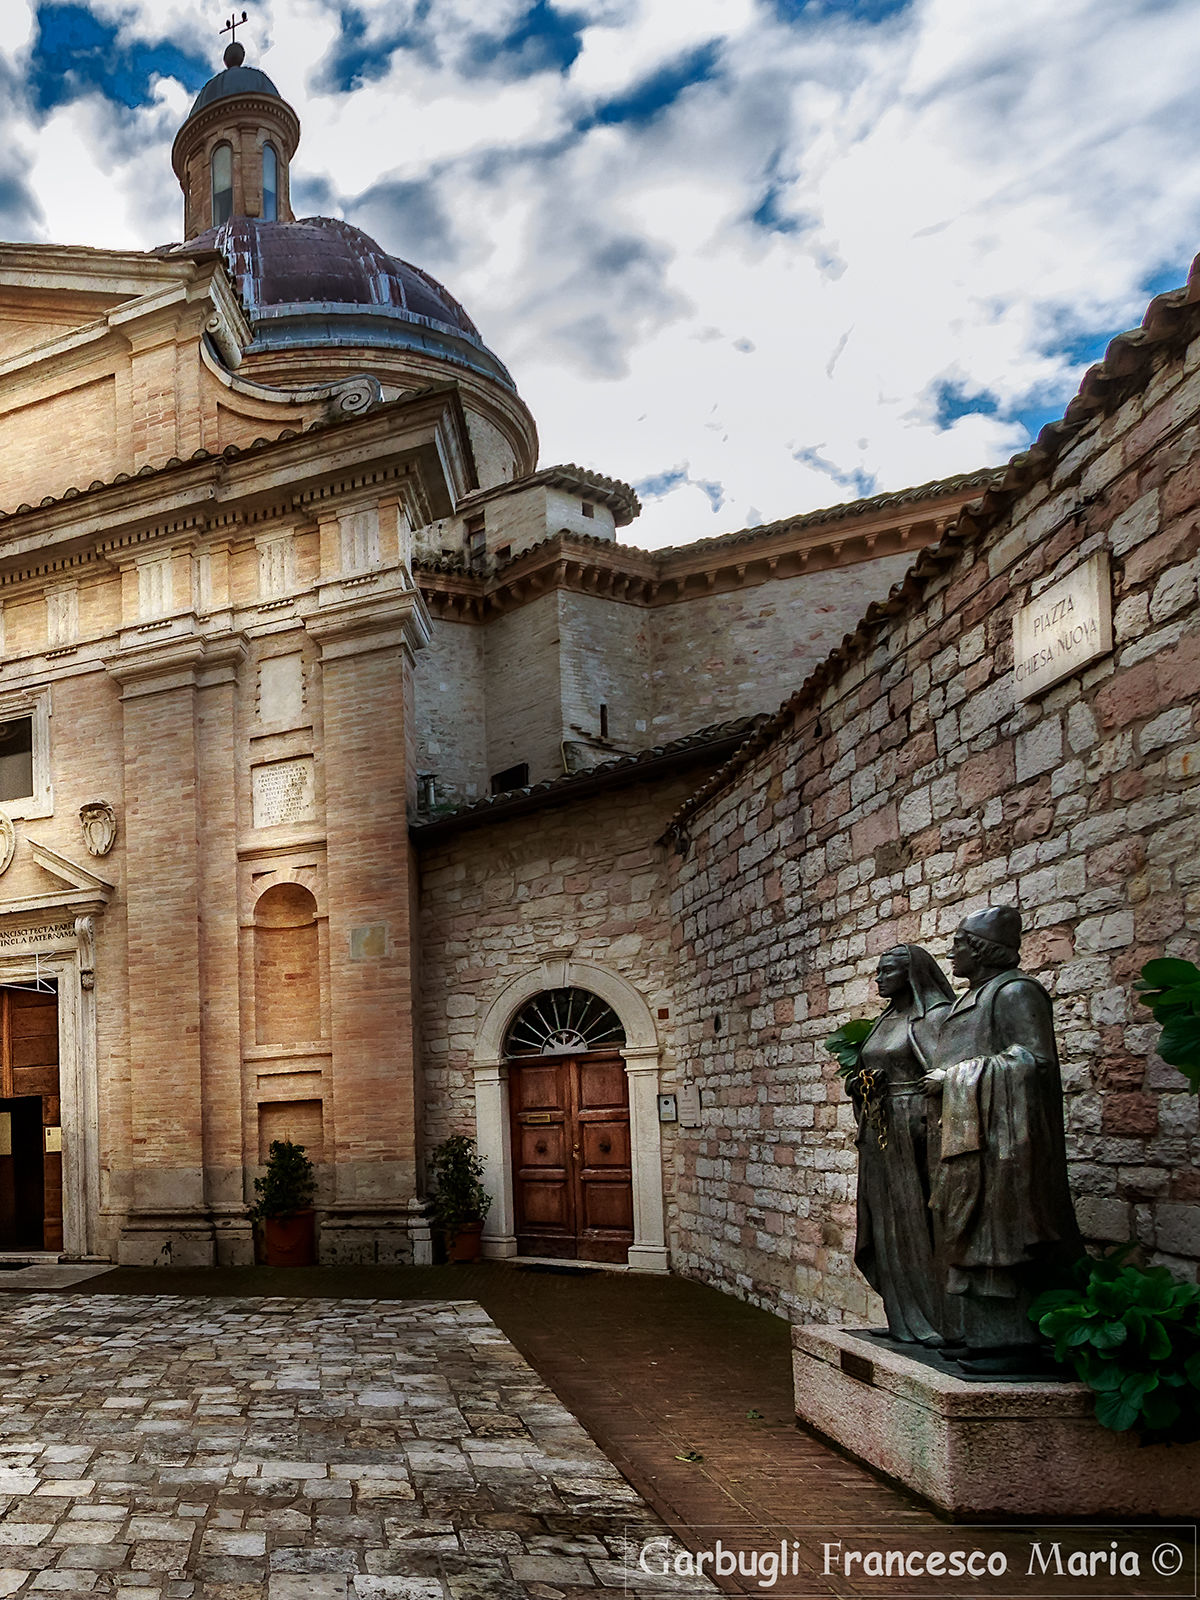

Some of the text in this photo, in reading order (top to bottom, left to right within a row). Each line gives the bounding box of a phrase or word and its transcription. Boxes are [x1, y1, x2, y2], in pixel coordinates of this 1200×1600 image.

[1033, 594, 1075, 637] PIAZZA
[1015, 617, 1098, 683] CHIESA NUOVA
